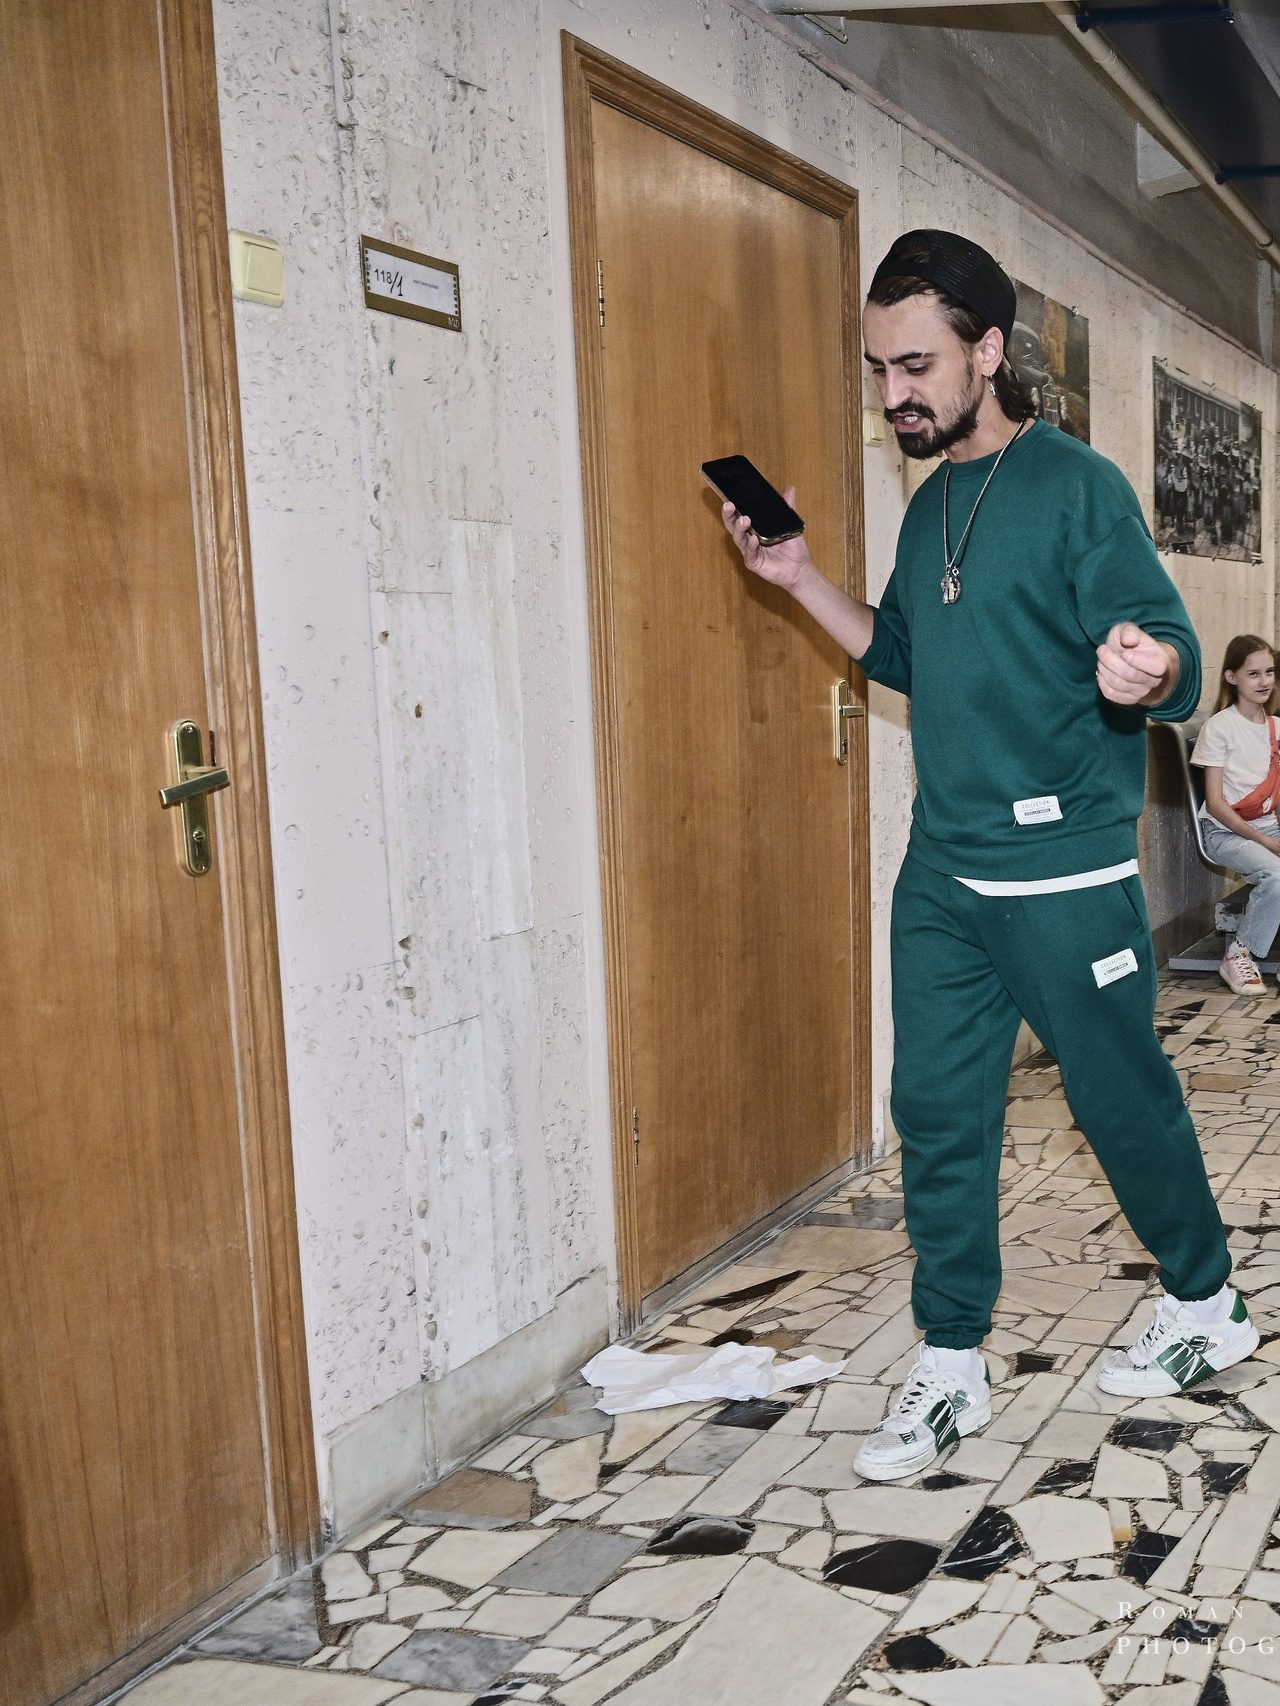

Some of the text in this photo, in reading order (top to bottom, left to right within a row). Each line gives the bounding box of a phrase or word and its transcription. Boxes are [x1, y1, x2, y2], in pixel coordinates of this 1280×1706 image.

[374, 268, 403, 296] 118/1
[1021, 800, 1050, 809] COLLECTION
[1162, 1343, 1207, 1385] TN
